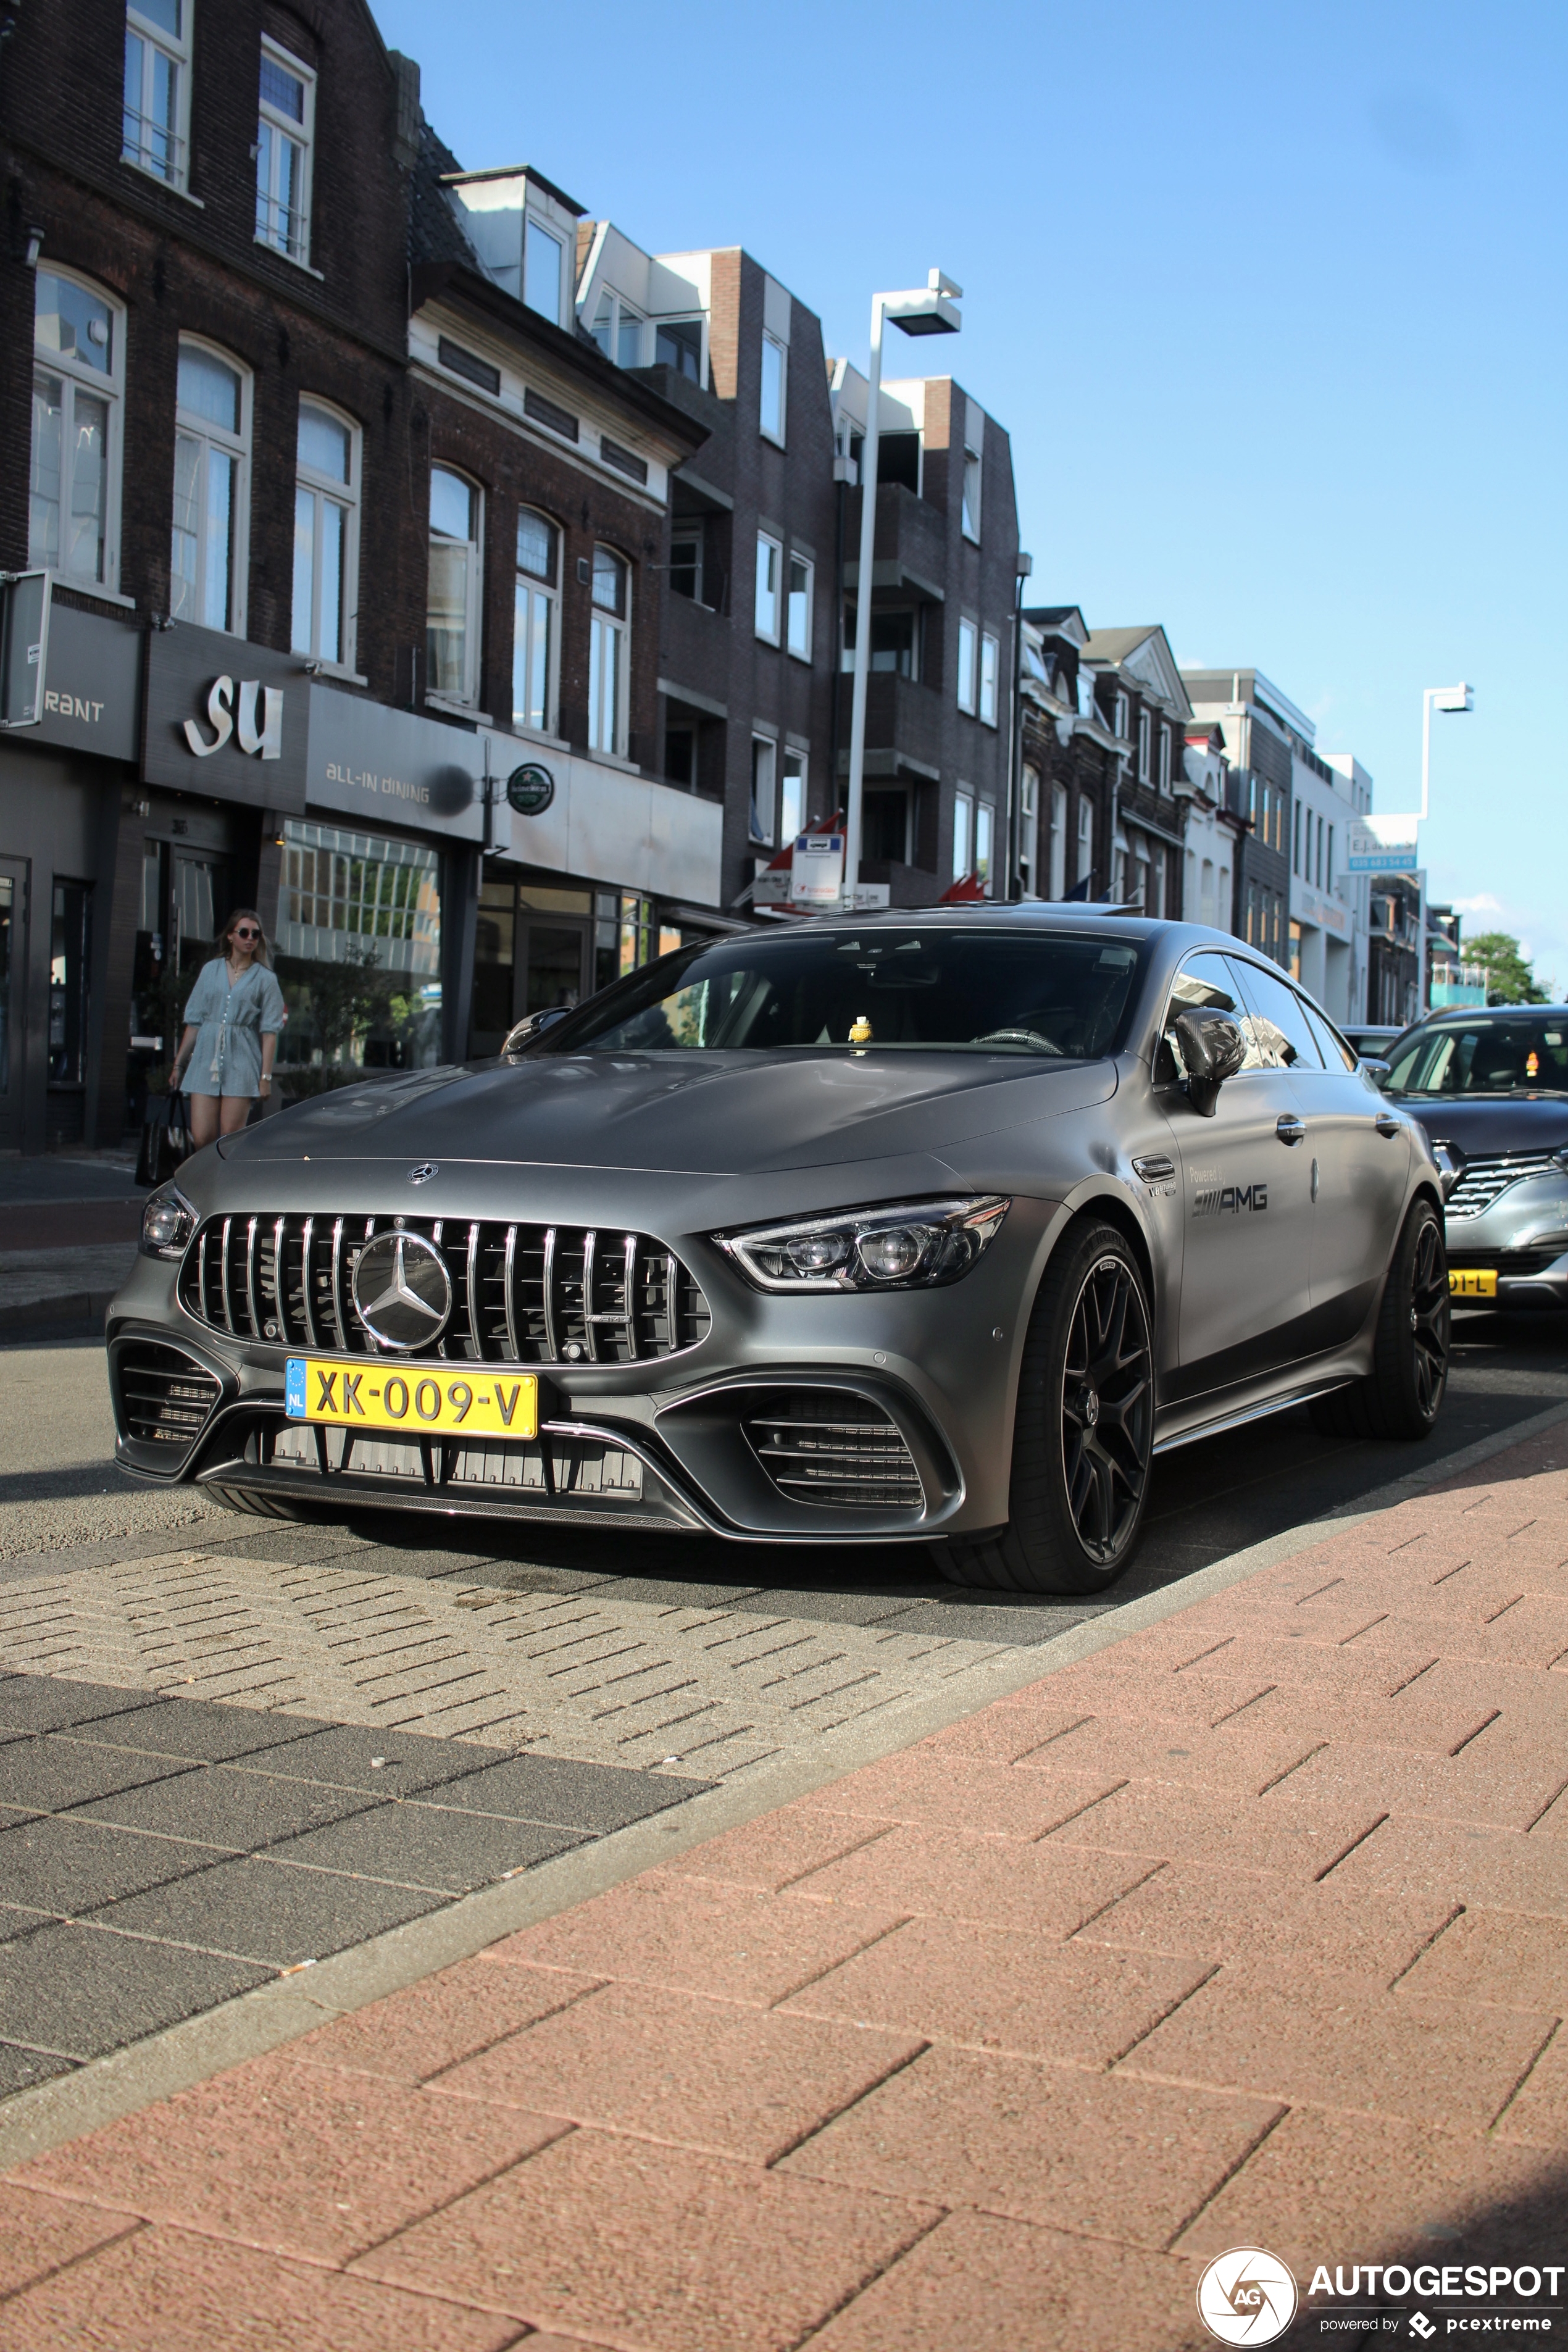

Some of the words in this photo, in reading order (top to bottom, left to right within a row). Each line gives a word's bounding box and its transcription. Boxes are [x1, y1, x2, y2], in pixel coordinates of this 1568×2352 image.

[1190, 1166, 1217, 1183] Powered
[289, 1393, 304, 1407] NL
[317, 1370, 520, 1426] XK-009-V
